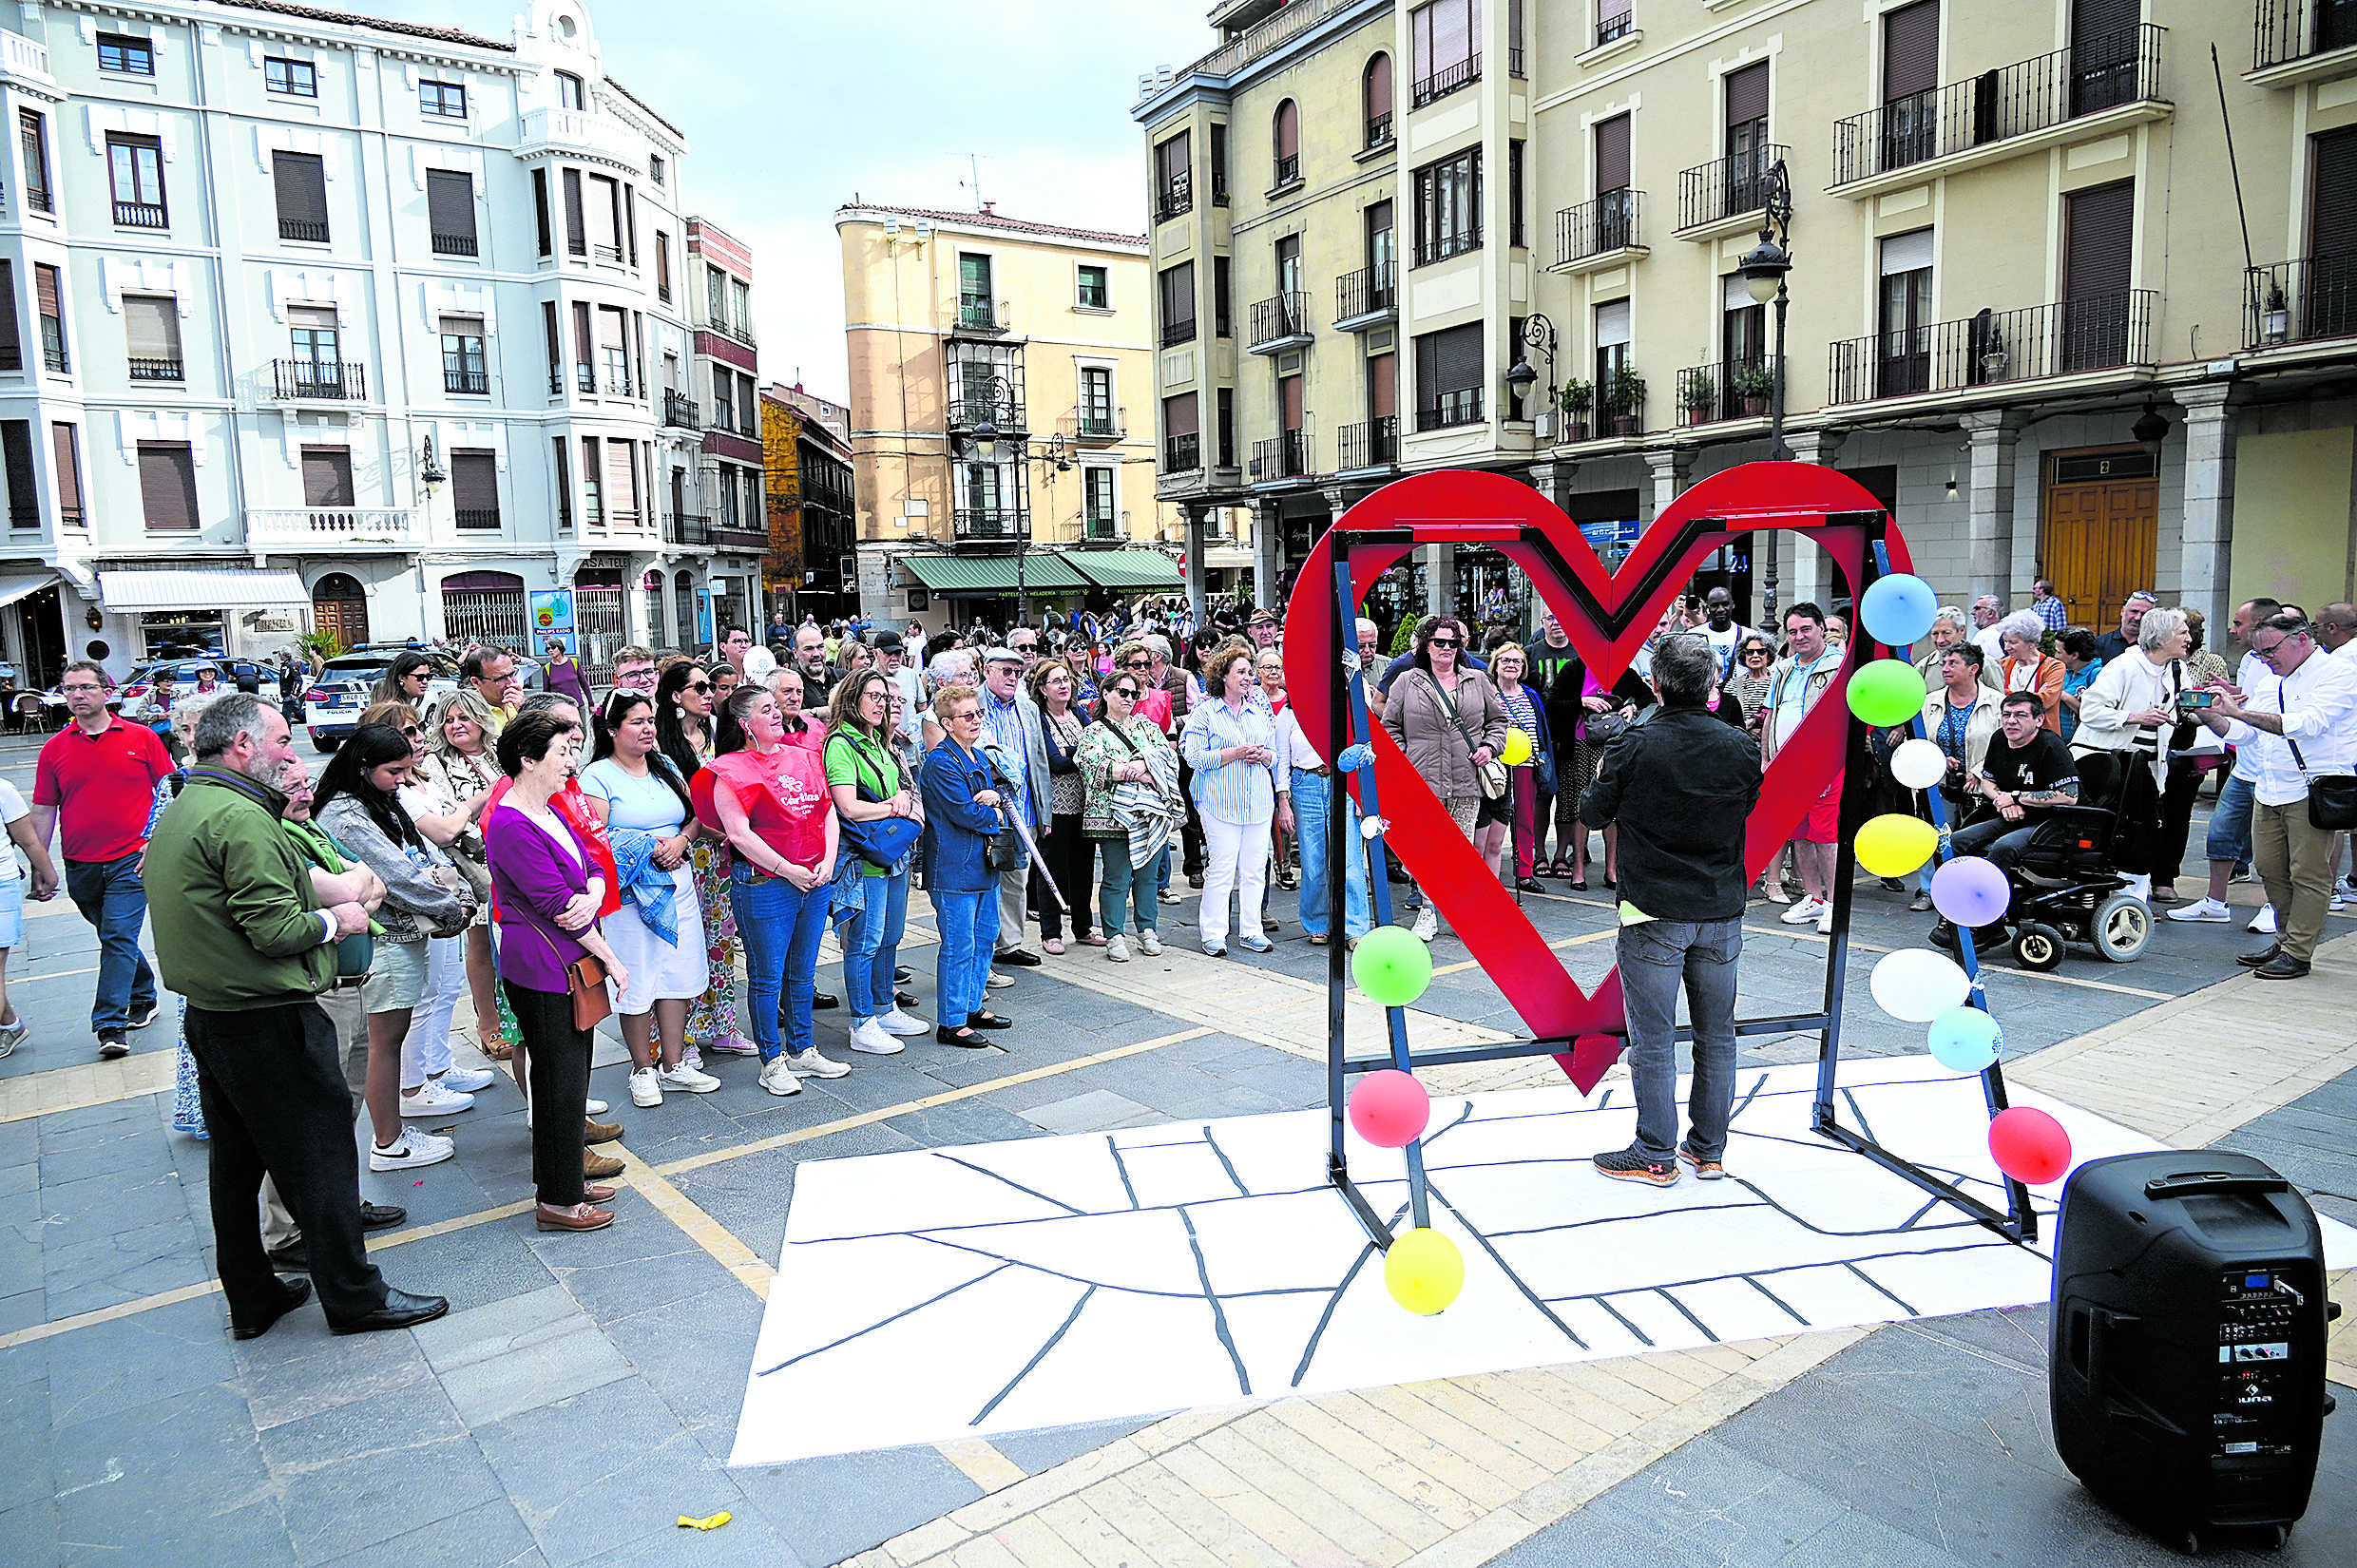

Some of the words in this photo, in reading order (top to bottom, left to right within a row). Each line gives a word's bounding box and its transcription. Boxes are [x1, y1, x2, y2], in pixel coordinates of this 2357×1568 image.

[2101, 462, 2109, 473] 2
[580, 557, 604, 568] ASA
[1730, 555, 1748, 573] 24
